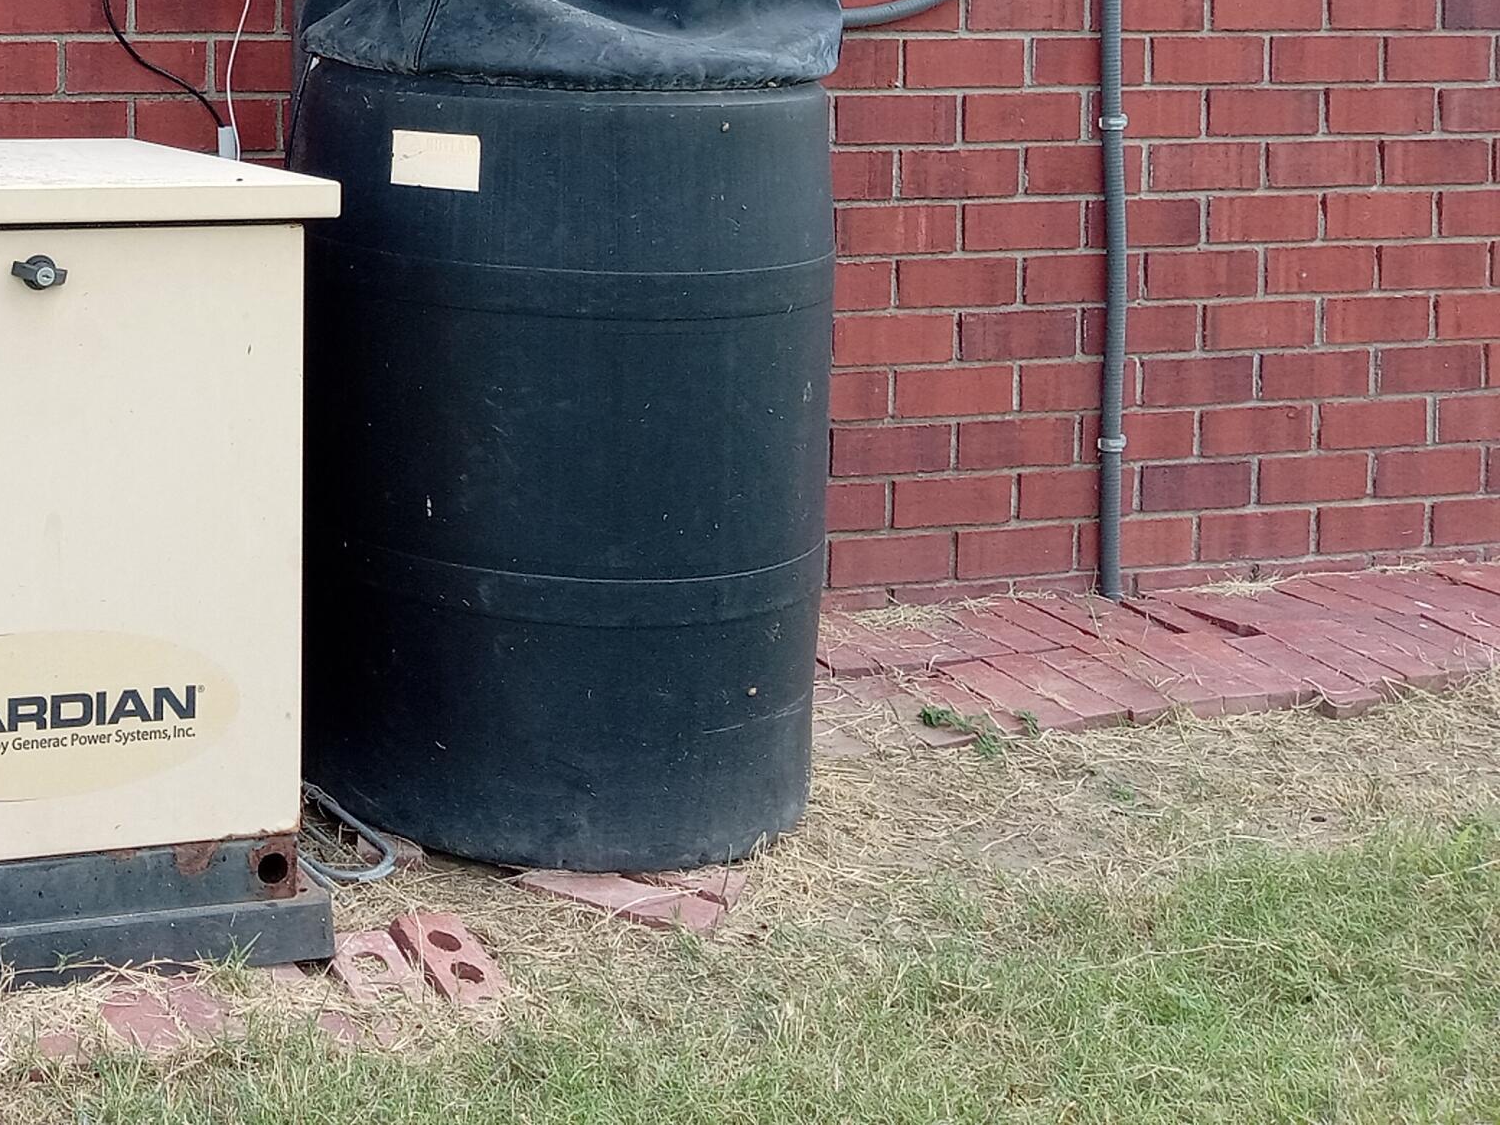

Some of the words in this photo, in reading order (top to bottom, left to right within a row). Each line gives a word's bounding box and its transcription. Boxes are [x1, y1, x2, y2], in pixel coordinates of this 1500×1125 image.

[12, 735, 68, 751] Generac
[71, 731, 112, 747] Power
[114, 727, 171, 746] Systems,
[173, 725, 196, 738] Inc.
